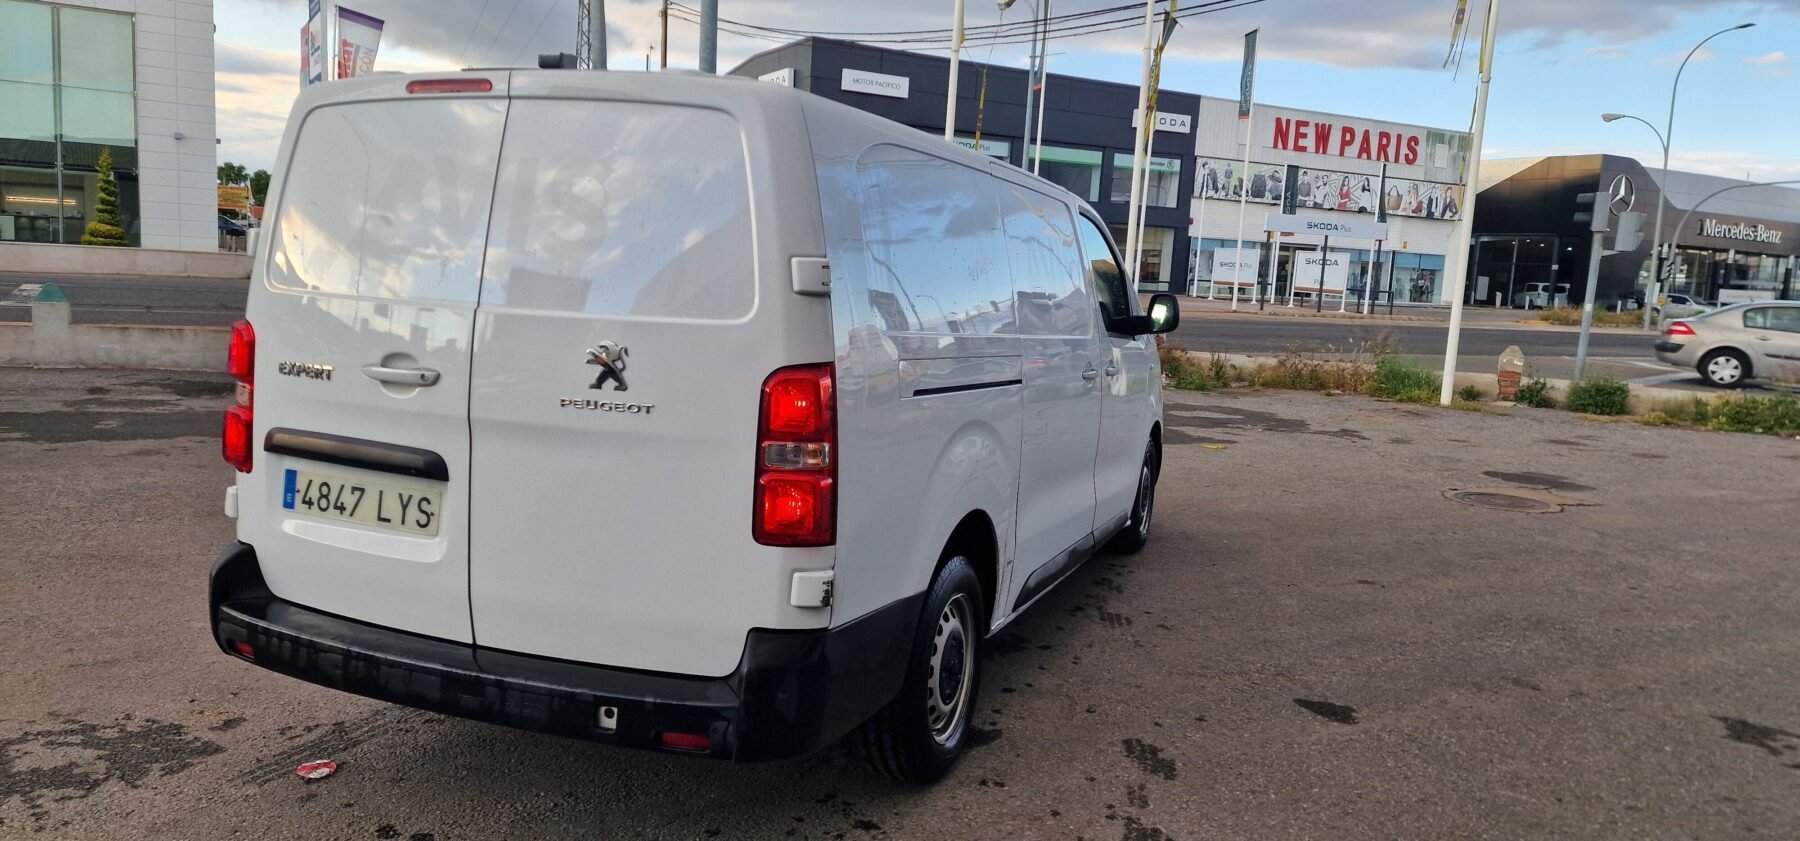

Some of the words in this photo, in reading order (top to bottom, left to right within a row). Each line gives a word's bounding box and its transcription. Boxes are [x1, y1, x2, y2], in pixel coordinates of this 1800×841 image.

[852, 77, 874, 86] MOTOR
[1159, 117, 1186, 128] ODA
[1273, 117, 1332, 154] NEW
[1340, 126, 1420, 165] PARIS
[1306, 221, 1339, 231] SKODA
[1340, 224, 1352, 233] Plus
[1703, 218, 1782, 244] Mercedes-Benz
[1305, 257, 1339, 266] SKODA
[278, 361, 335, 381] EXPERT
[559, 397, 655, 415] PEUGEOT
[301, 479, 366, 517] 4847
[376, 490, 435, 529] LYS
